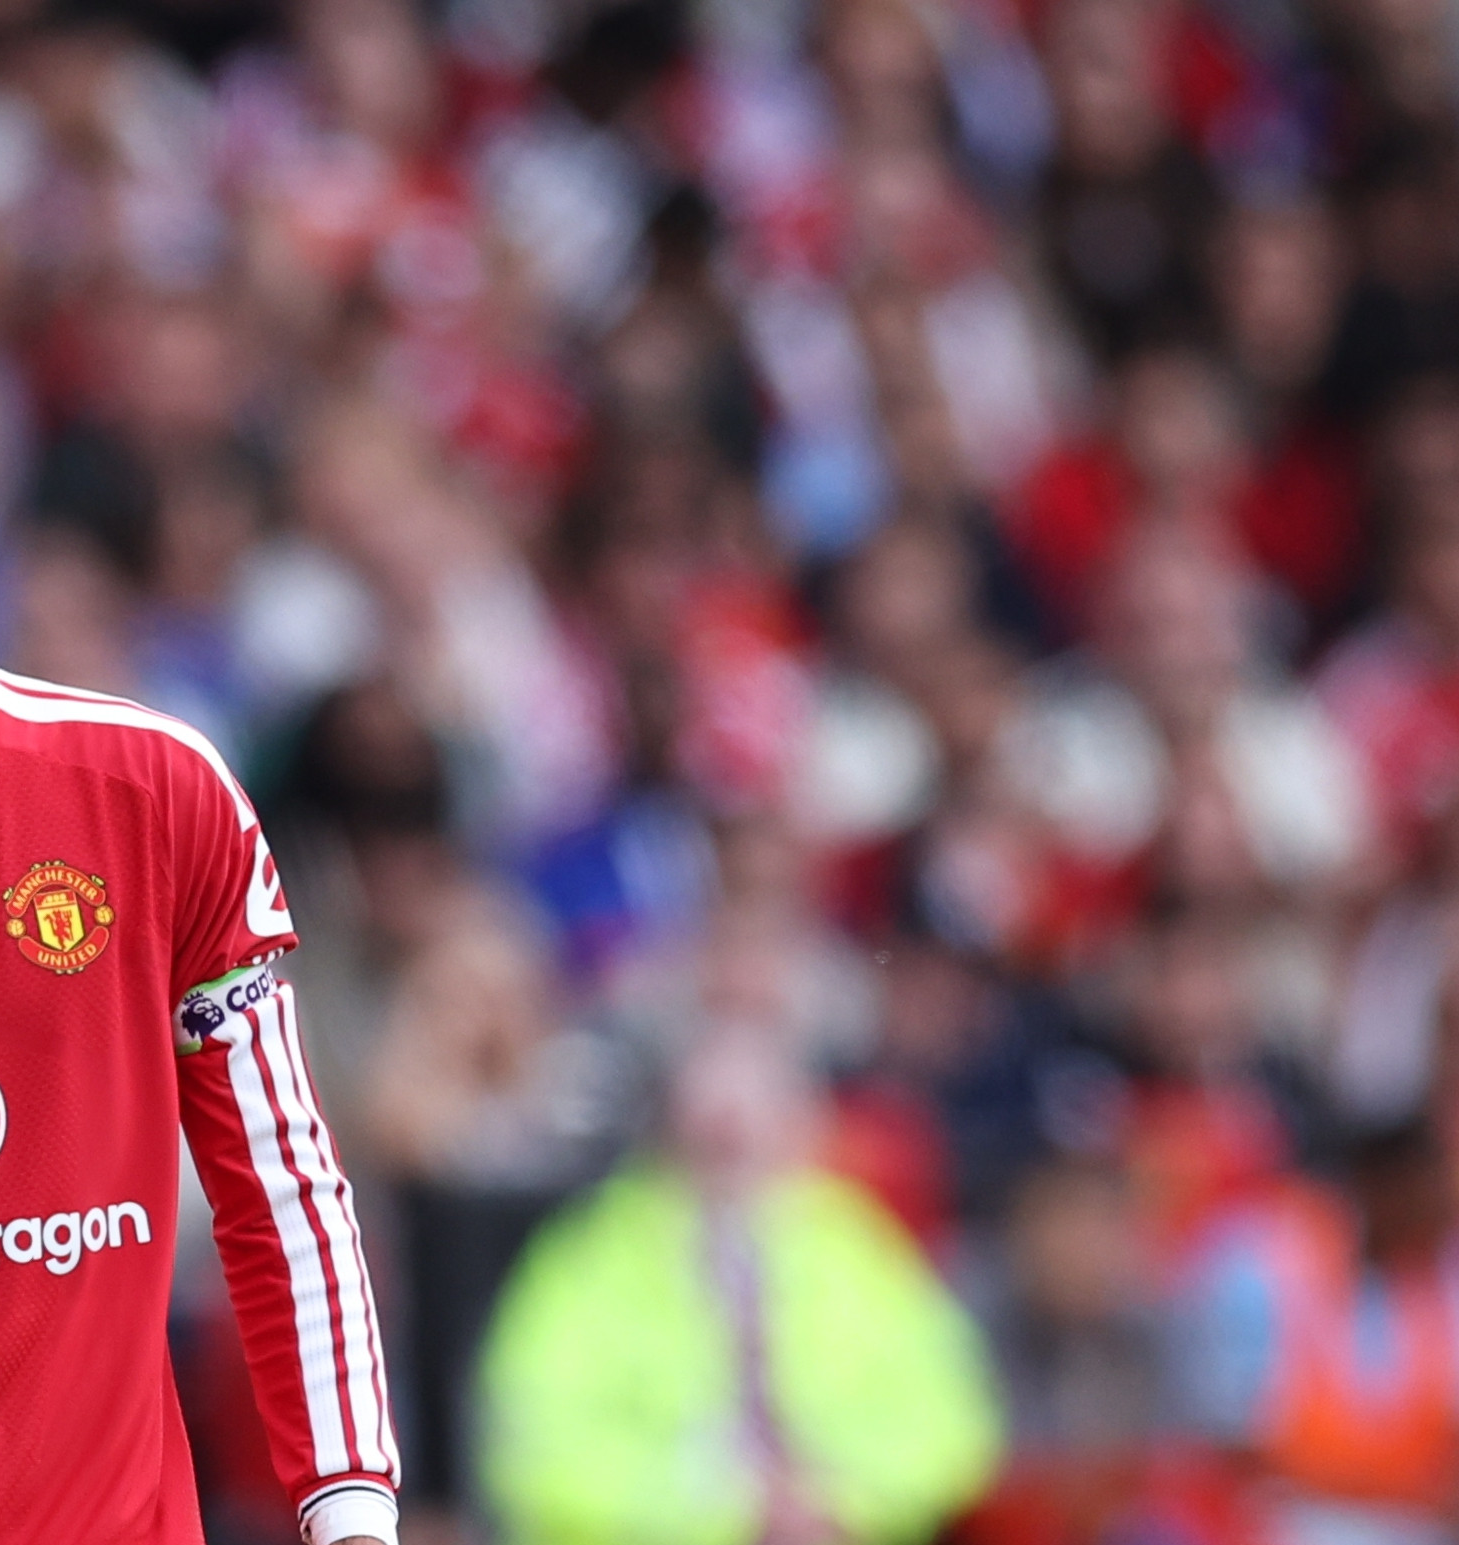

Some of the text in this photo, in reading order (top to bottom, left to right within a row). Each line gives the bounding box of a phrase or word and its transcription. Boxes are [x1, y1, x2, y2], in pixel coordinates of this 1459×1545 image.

[12, 869, 98, 910] MANCHESTER
[37, 943, 97, 967] UNITED
[225, 966, 274, 1013] Cap
